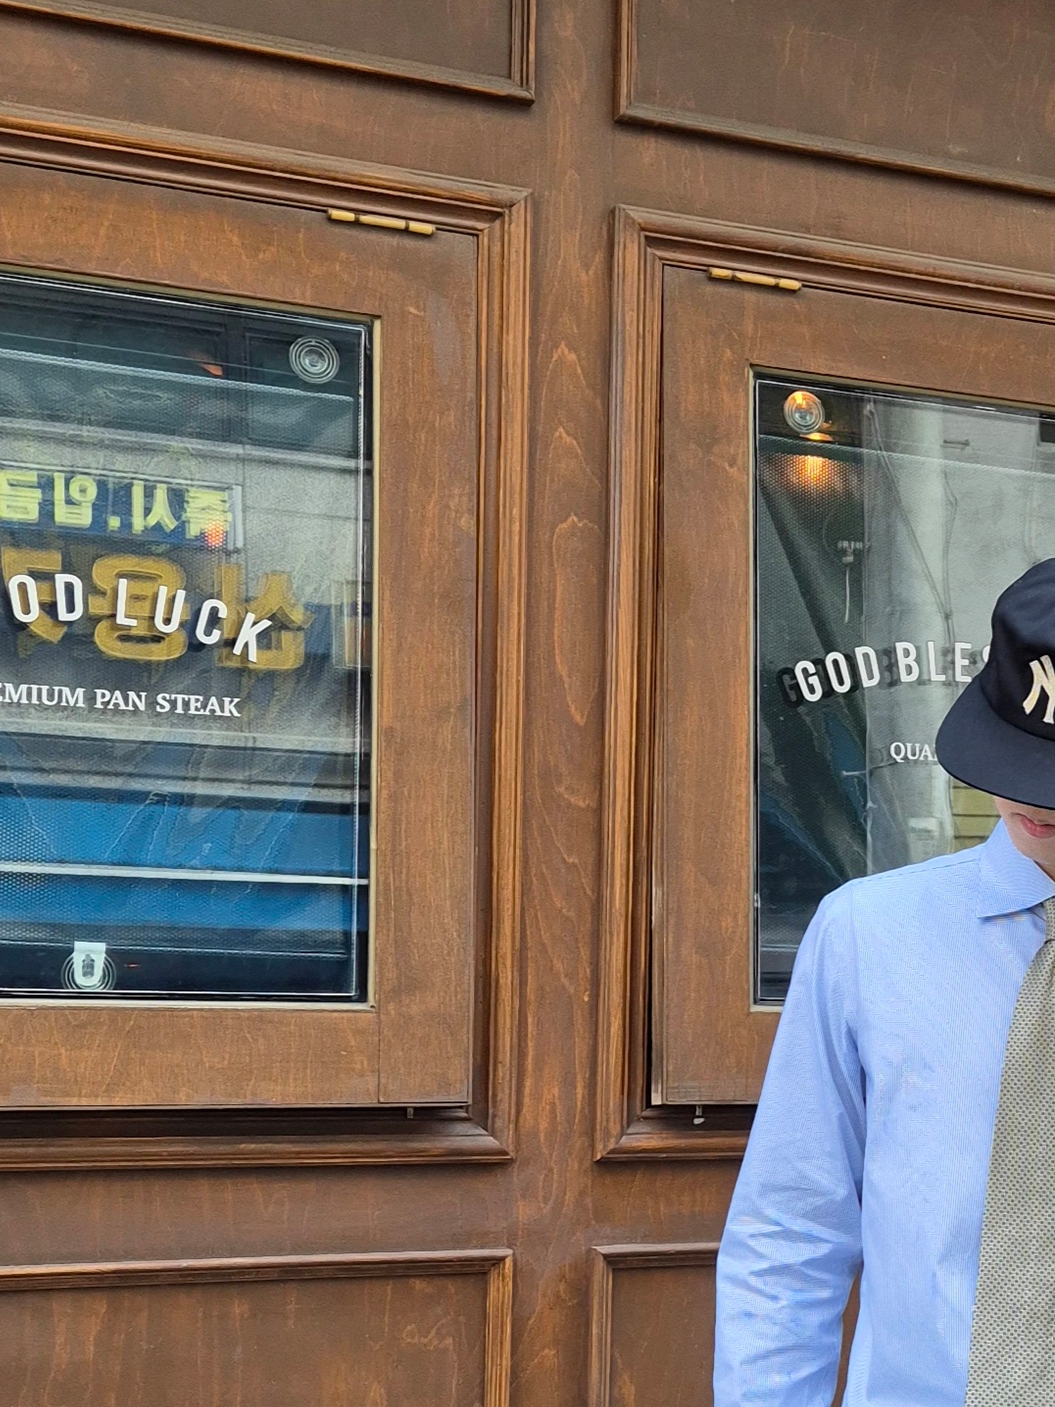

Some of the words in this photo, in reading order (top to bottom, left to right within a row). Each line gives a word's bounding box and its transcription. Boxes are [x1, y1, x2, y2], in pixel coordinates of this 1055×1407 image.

[8, 573, 84, 623] OD
[116, 577, 273, 663] LUCK
[794, 645, 880, 702] GOD
[0, 682, 85, 708] MIUM
[93, 688, 148, 712] PAN
[155, 692, 242, 717] STEAK
[889, 742, 938, 763] QUA
